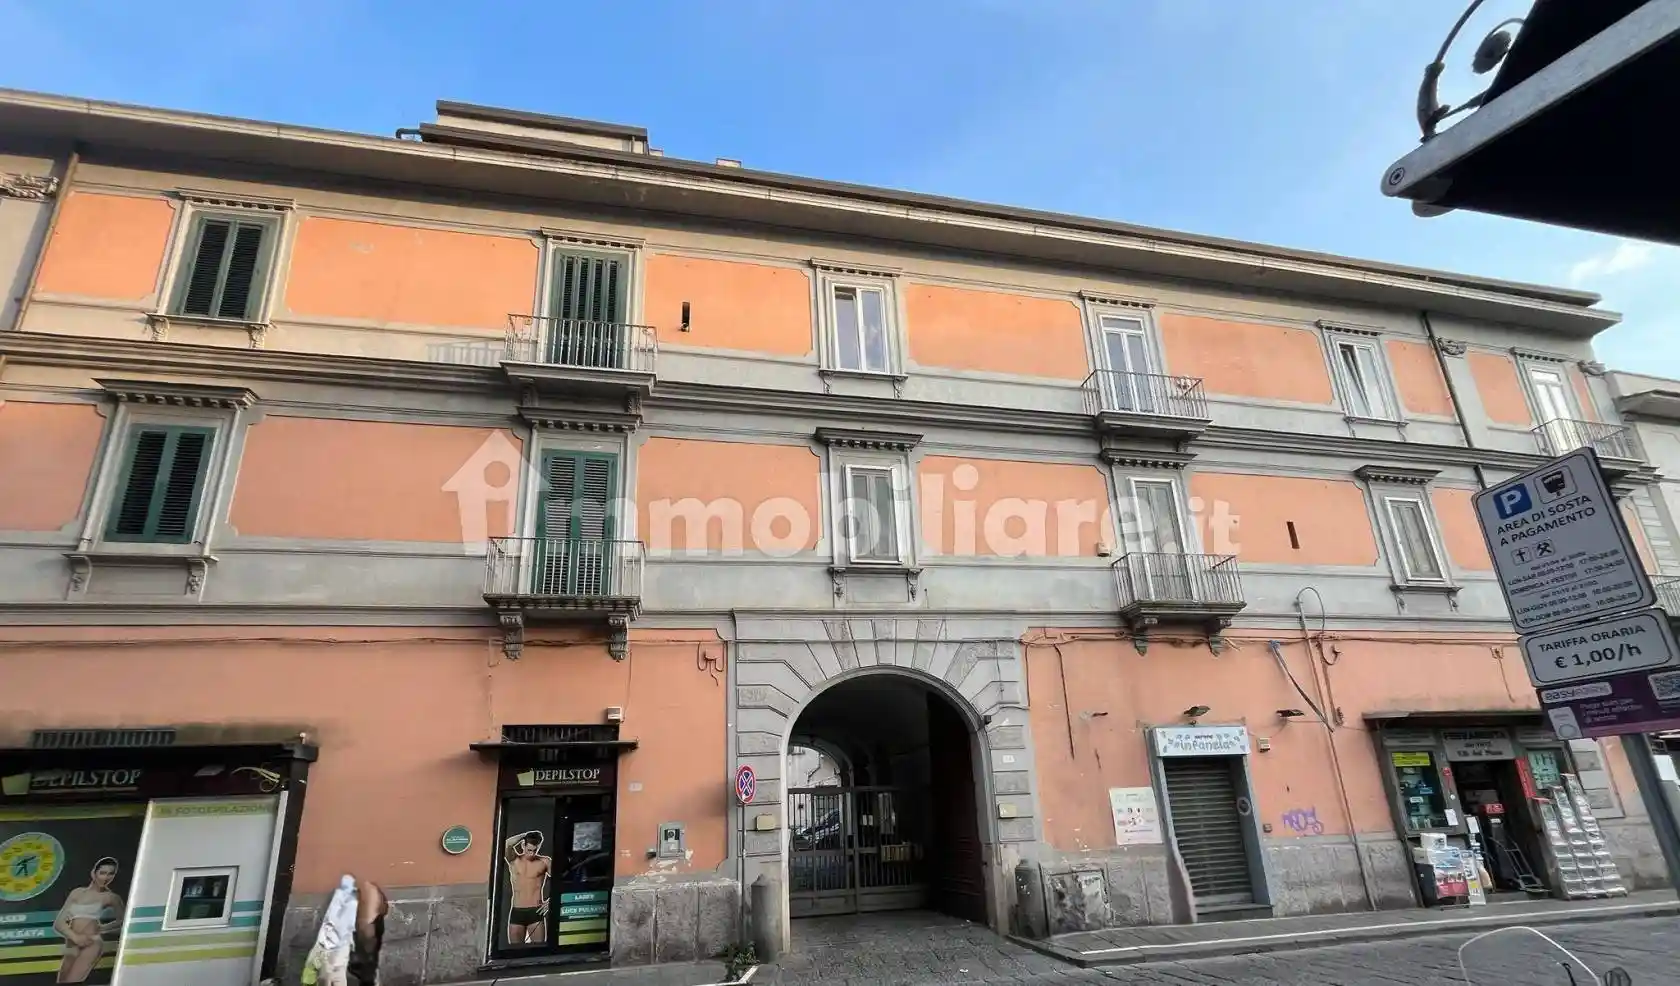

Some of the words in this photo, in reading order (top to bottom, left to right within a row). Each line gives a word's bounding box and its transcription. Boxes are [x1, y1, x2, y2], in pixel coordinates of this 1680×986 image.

[1497, 518, 1530, 535] AREA
[1531, 511, 1545, 522] DI
[1547, 495, 1592, 516] SOSTA
[1500, 490, 1521, 515] P
[1500, 537, 1509, 547] A
[1511, 507, 1595, 543] PAGAMENTO
[1539, 636, 1588, 652] TARIFFA
[1591, 625, 1646, 642] ORARIA
[1554, 656, 1568, 669] €
[1572, 643, 1642, 667] 1,00/h
[535, 768, 600, 781] DEPILSTOP
